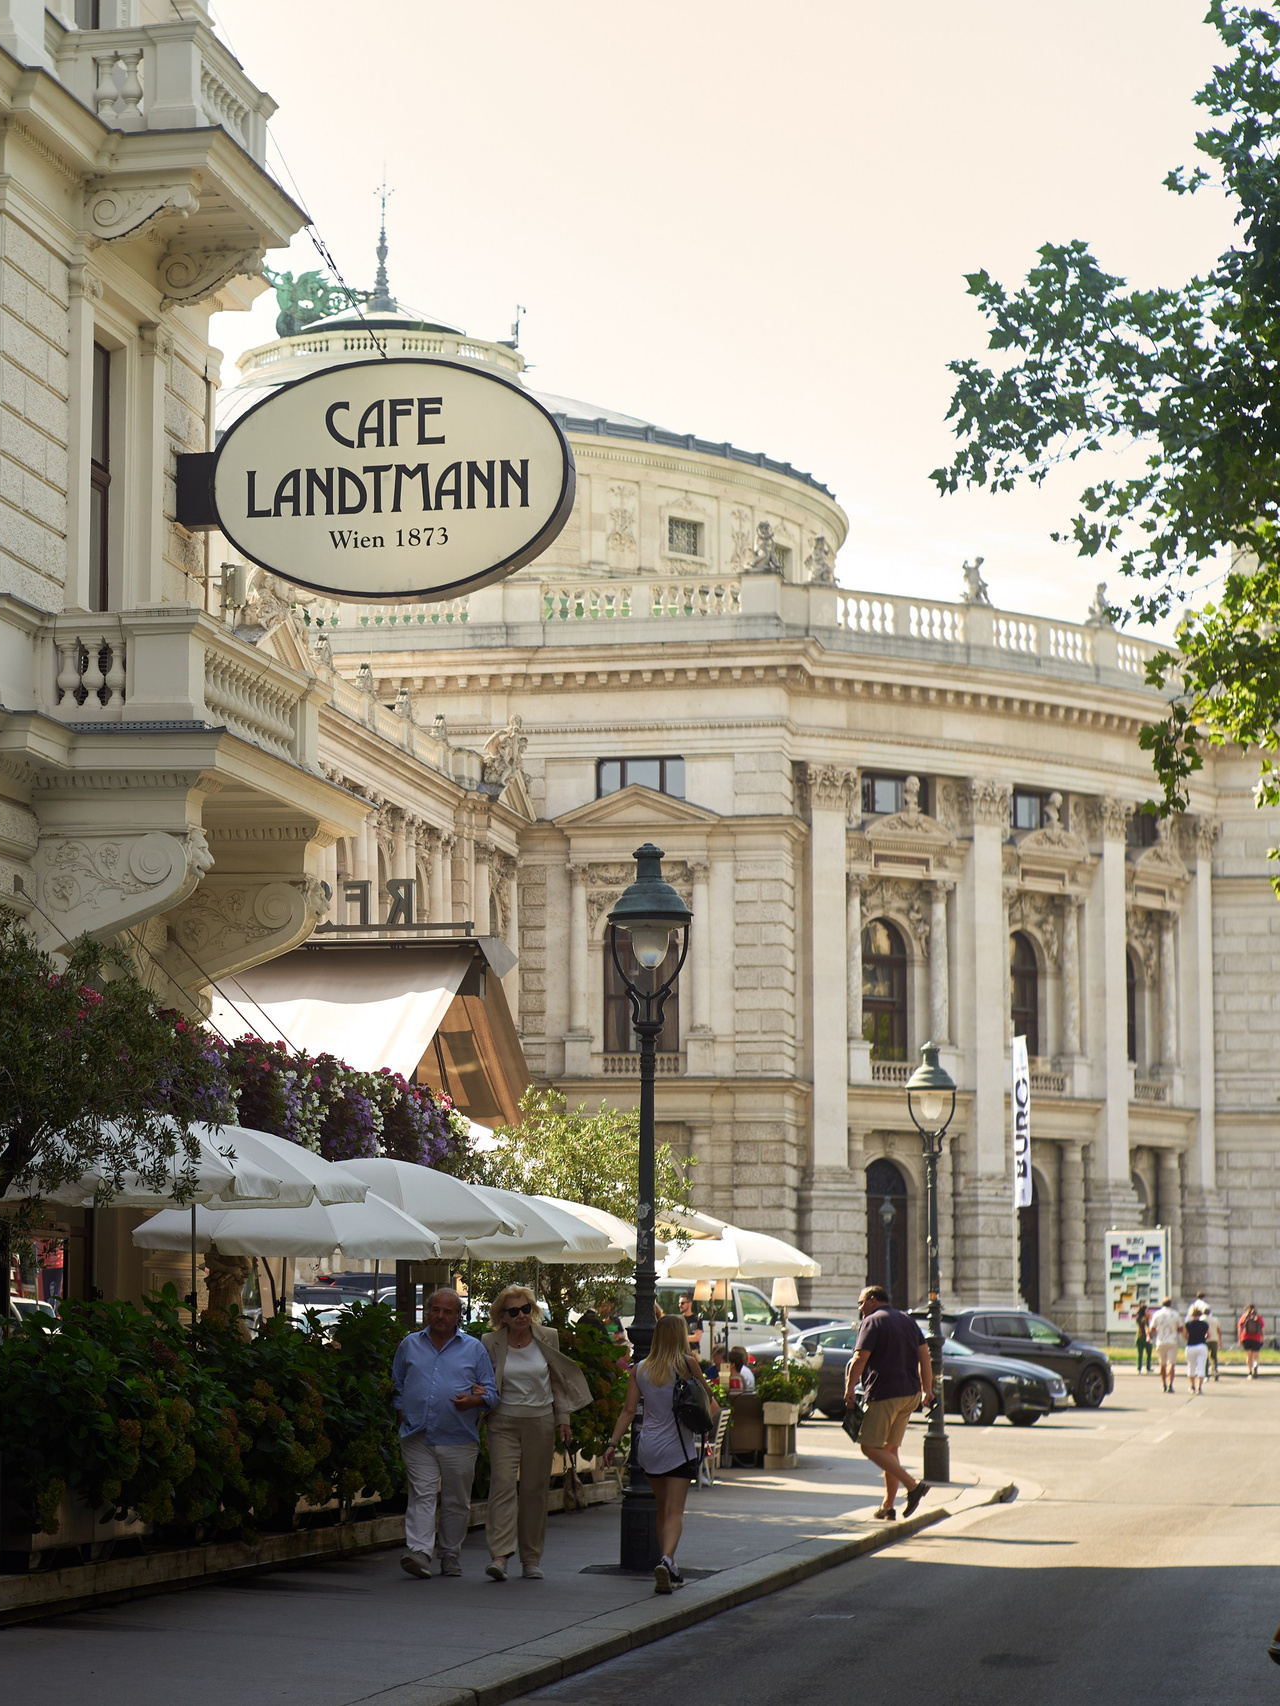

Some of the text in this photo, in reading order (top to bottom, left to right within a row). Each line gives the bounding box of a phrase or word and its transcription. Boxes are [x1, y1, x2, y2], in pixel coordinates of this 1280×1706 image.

[325, 397, 445, 449] CAFE
[246, 459, 530, 518] LANDTMANN
[328, 527, 449, 549] Wien 1873
